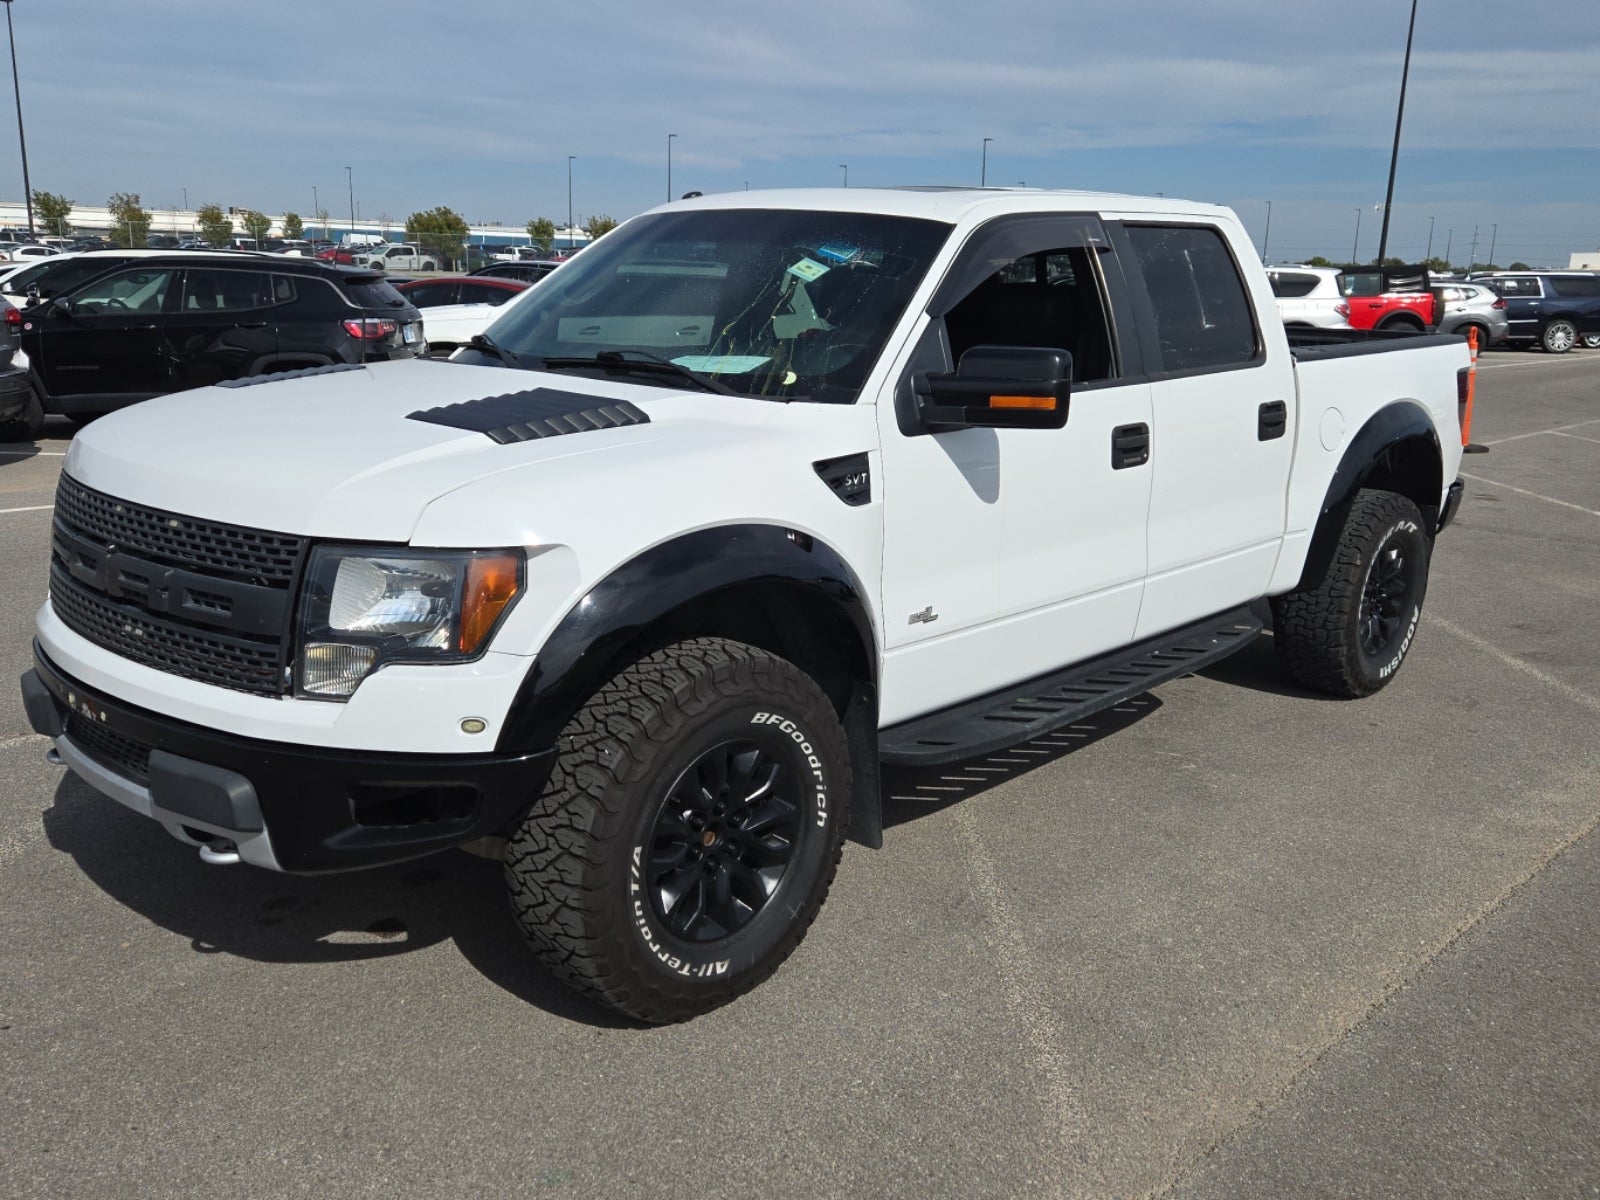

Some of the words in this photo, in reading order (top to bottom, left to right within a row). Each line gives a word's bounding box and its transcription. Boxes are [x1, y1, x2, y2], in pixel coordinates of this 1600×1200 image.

[845, 472, 867, 486] SVT
[750, 711, 828, 827] BFGoodrich
[631, 845, 642, 895] T/A
[634, 900, 730, 977] All-Terrain
